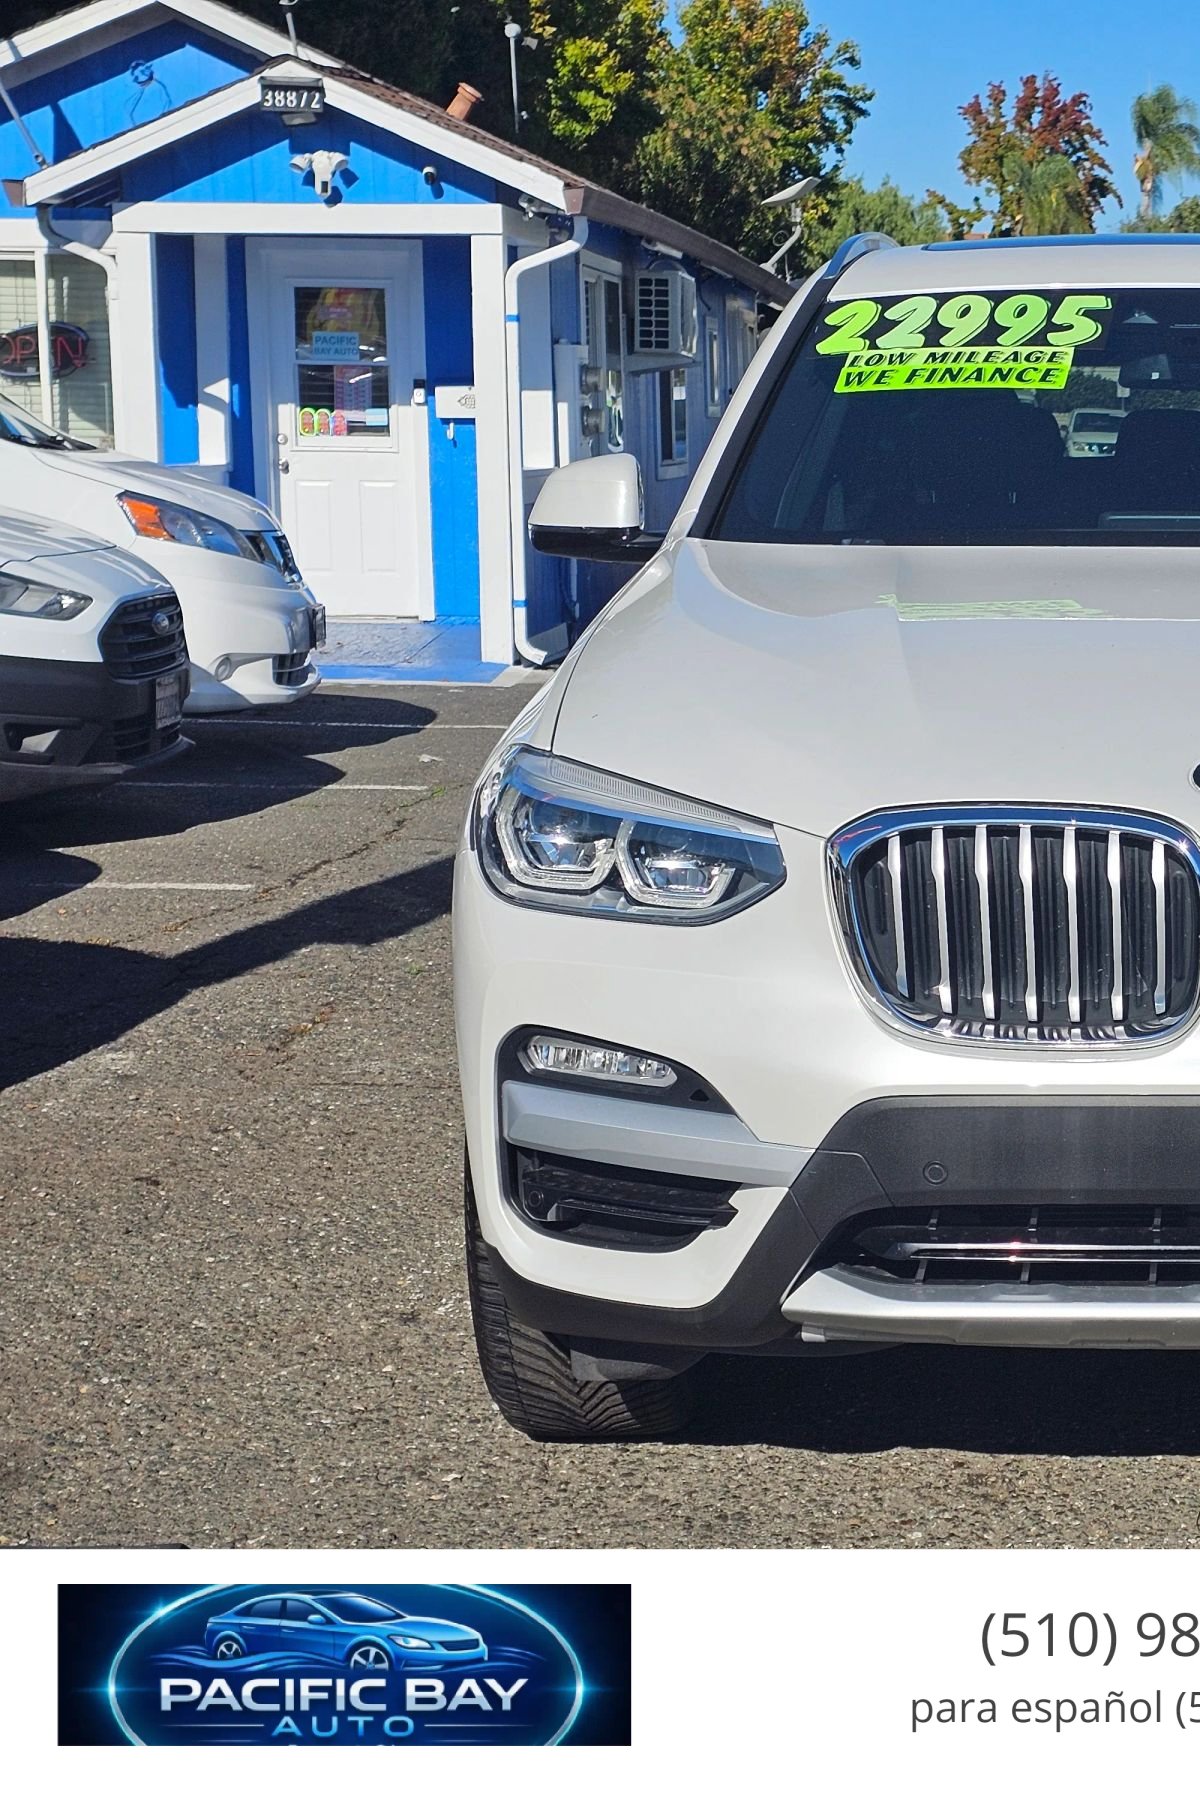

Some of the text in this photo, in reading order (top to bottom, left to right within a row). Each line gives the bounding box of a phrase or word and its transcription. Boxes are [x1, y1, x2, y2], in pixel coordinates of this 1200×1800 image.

[264, 88, 321, 109] 38872
[815, 294, 1113, 355] 22995
[0, 333, 84, 368] OPN
[315, 335, 357, 345] PACIFIC
[333, 346, 359, 356] AUTO
[849, 350, 1067, 368] LOW MILEAGE
[843, 366, 1061, 387] WE FINANCE
